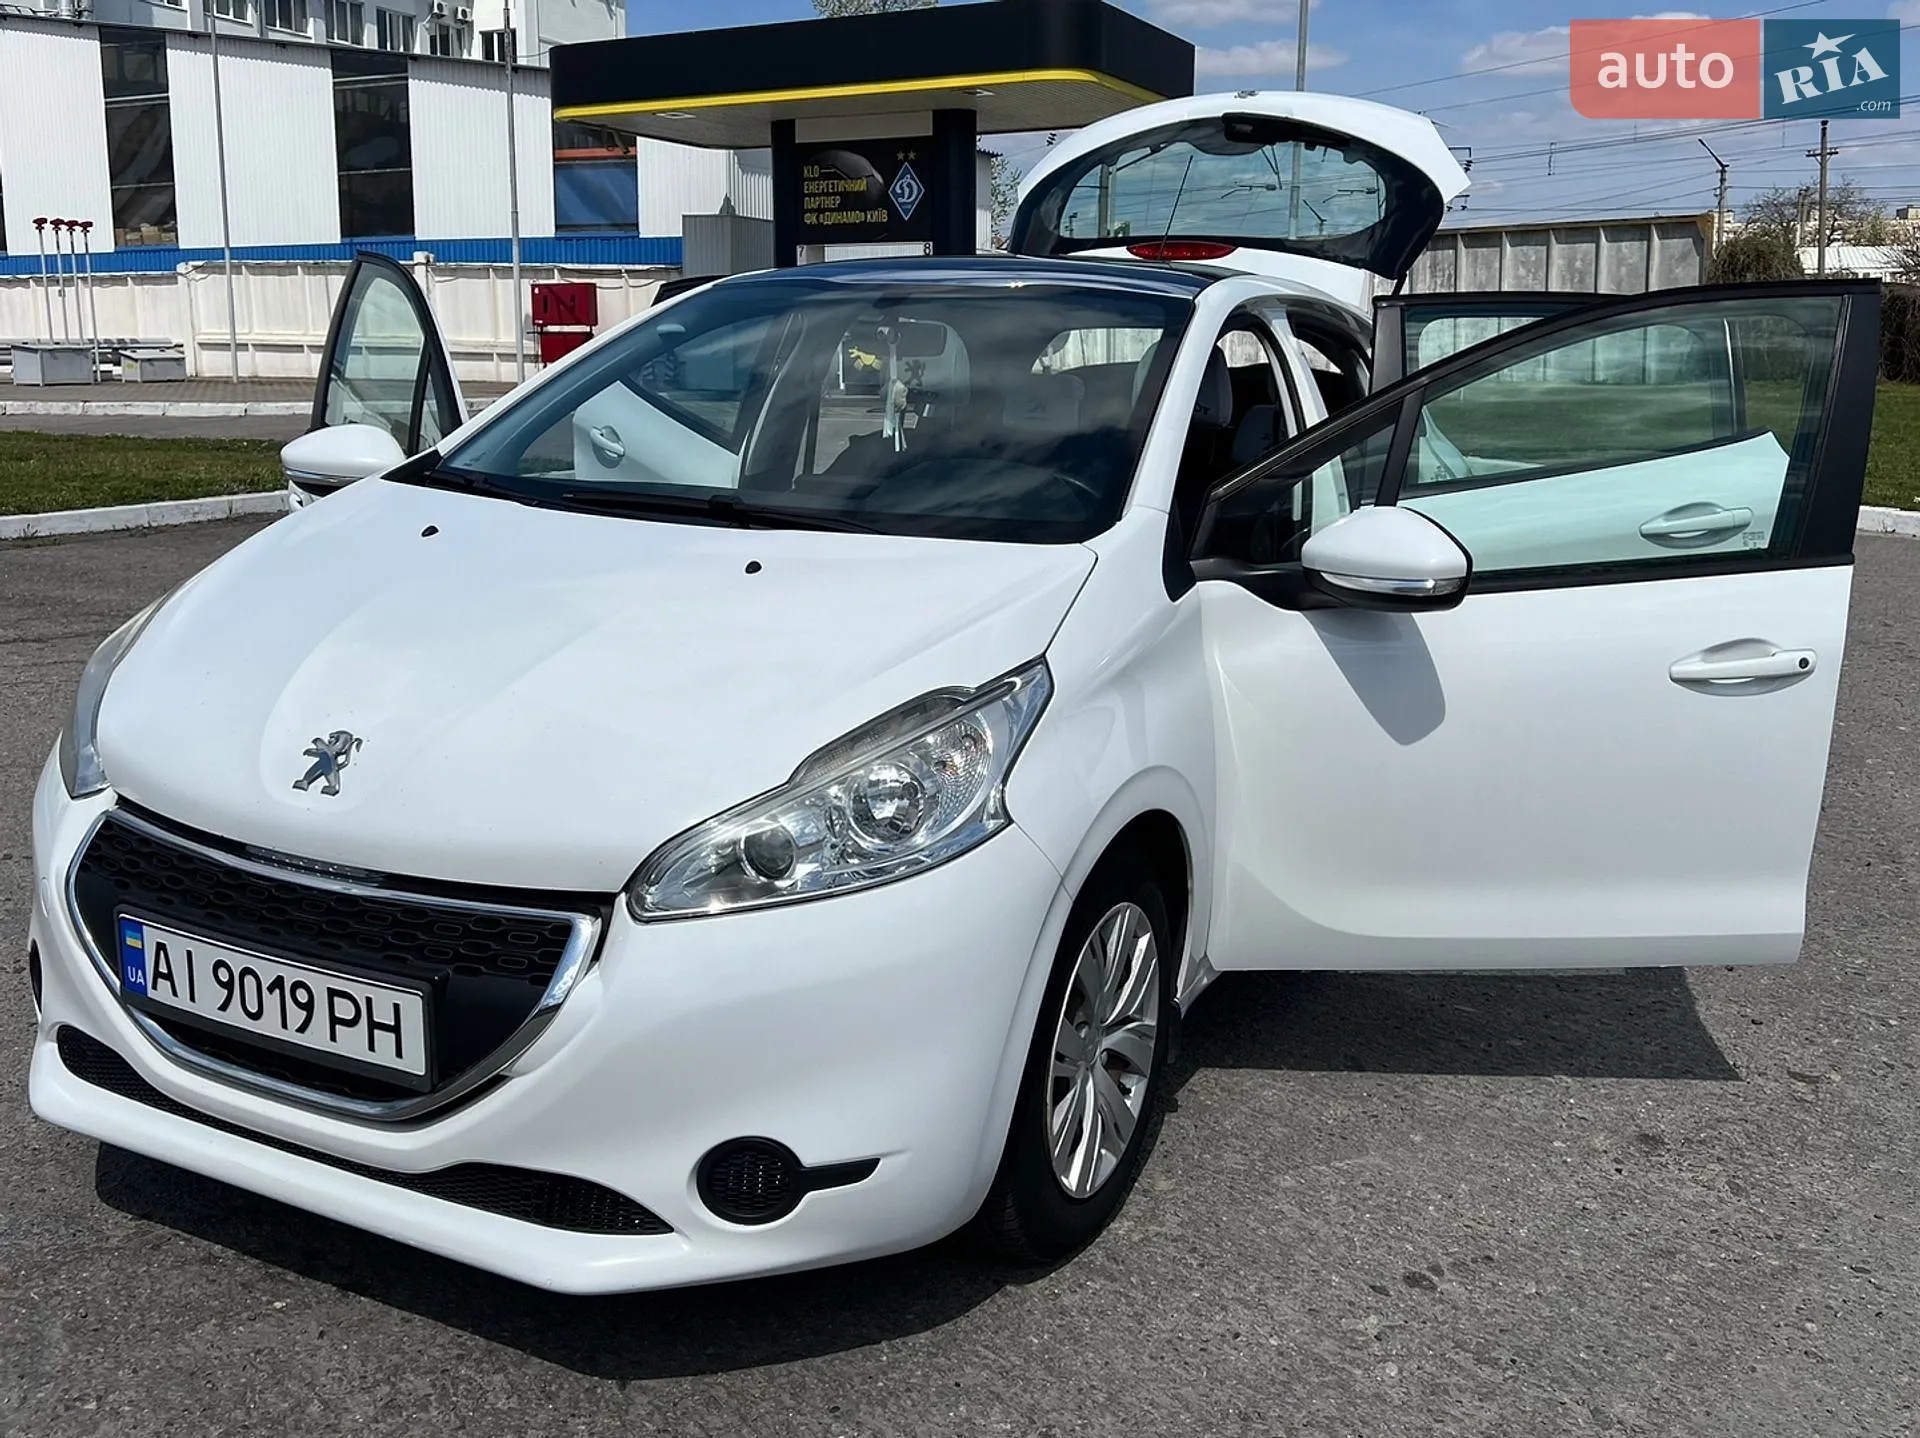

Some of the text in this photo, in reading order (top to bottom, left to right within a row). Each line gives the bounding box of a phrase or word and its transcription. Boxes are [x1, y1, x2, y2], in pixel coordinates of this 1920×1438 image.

[803, 177, 868, 193] ЕНЕРГЕТИЧНИЙ
[803, 196, 841, 210] ПАРТНЕР
[803, 208, 888, 226] ФК «ДИНАМО» КИЇВ
[923, 242, 932, 256] 8
[127, 966, 146, 986] UA
[151, 941, 404, 1060] AI 9019 PH
